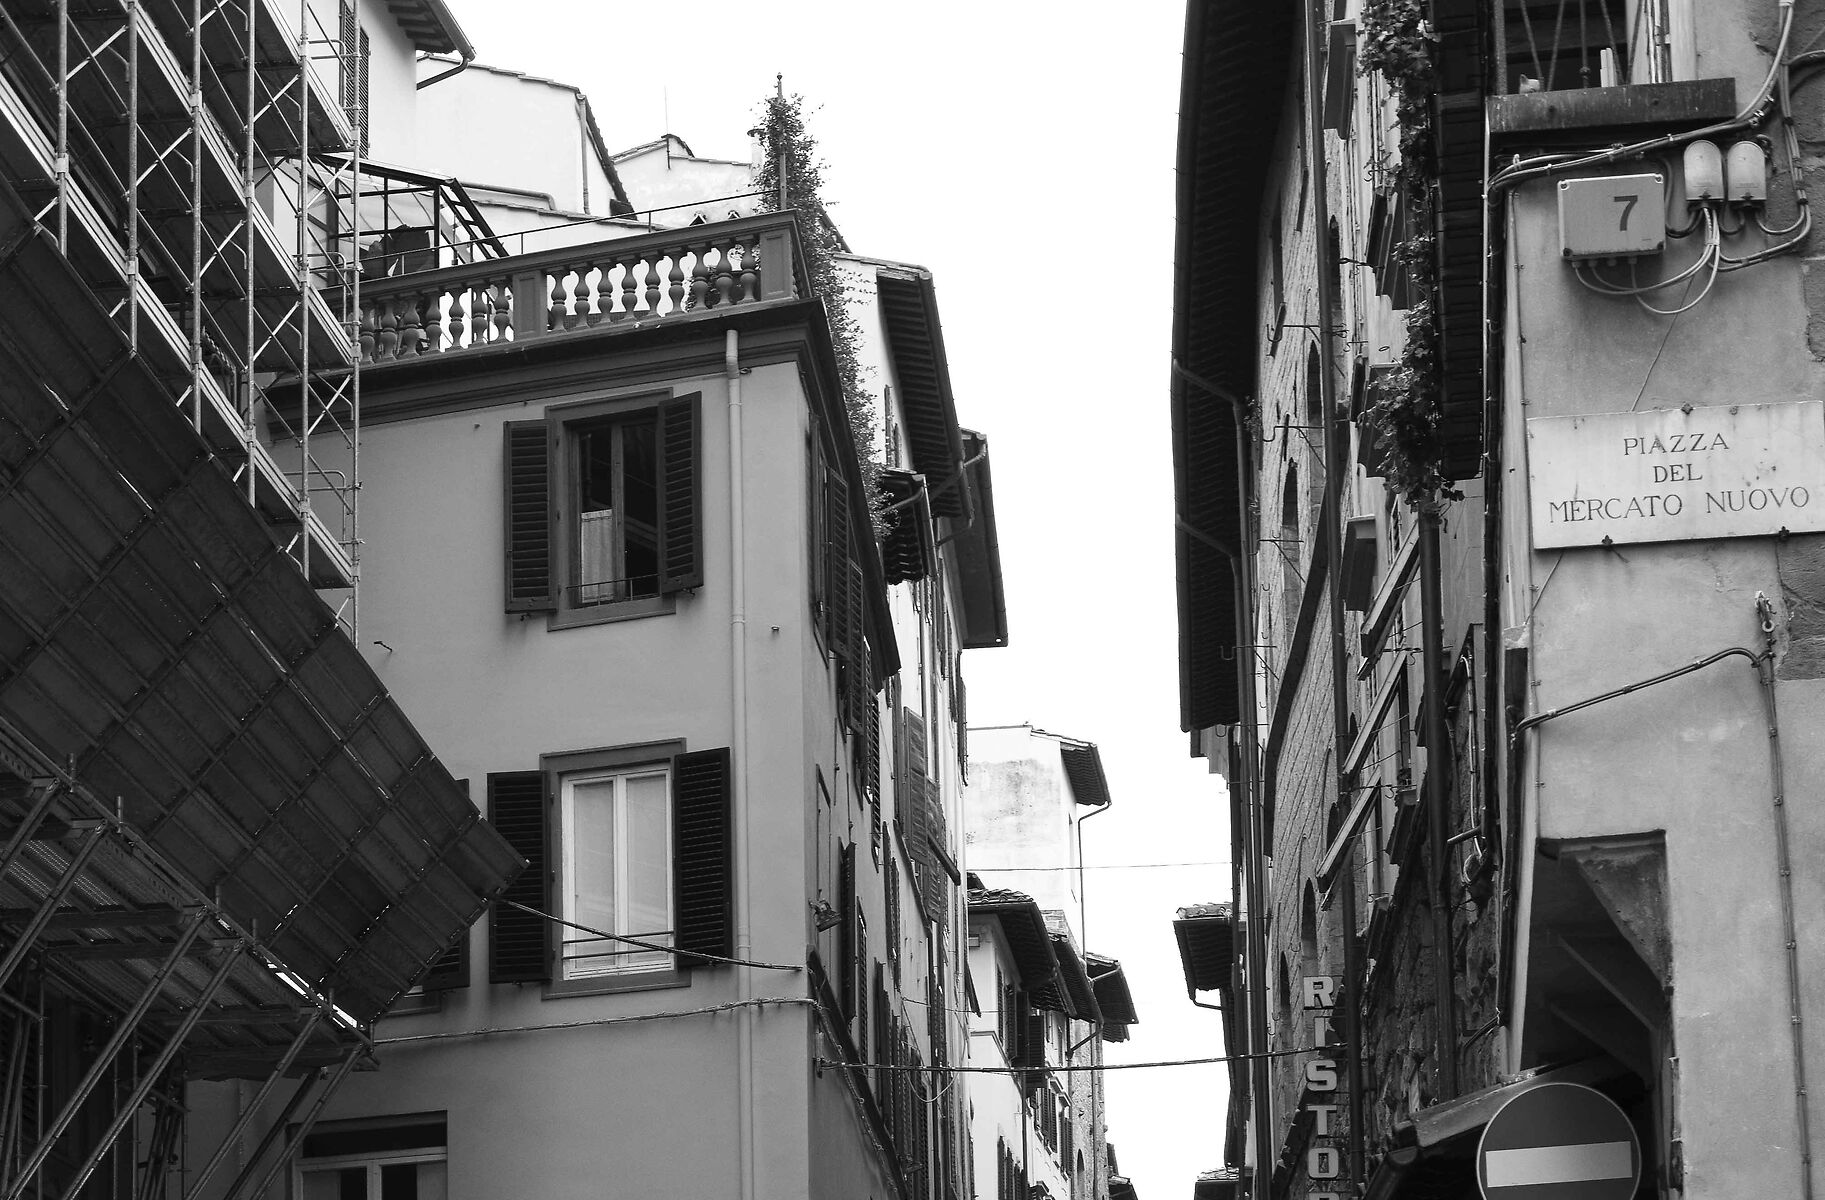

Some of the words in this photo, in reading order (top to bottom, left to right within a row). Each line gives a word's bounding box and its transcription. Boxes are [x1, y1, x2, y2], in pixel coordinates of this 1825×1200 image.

[1614, 195, 1638, 231] 7
[1623, 433, 1730, 456] PIAZZA
[1653, 464, 1703, 483] DEL
[1549, 494, 1683, 523] MERCATO
[1705, 486, 1810, 513] NUOVO
